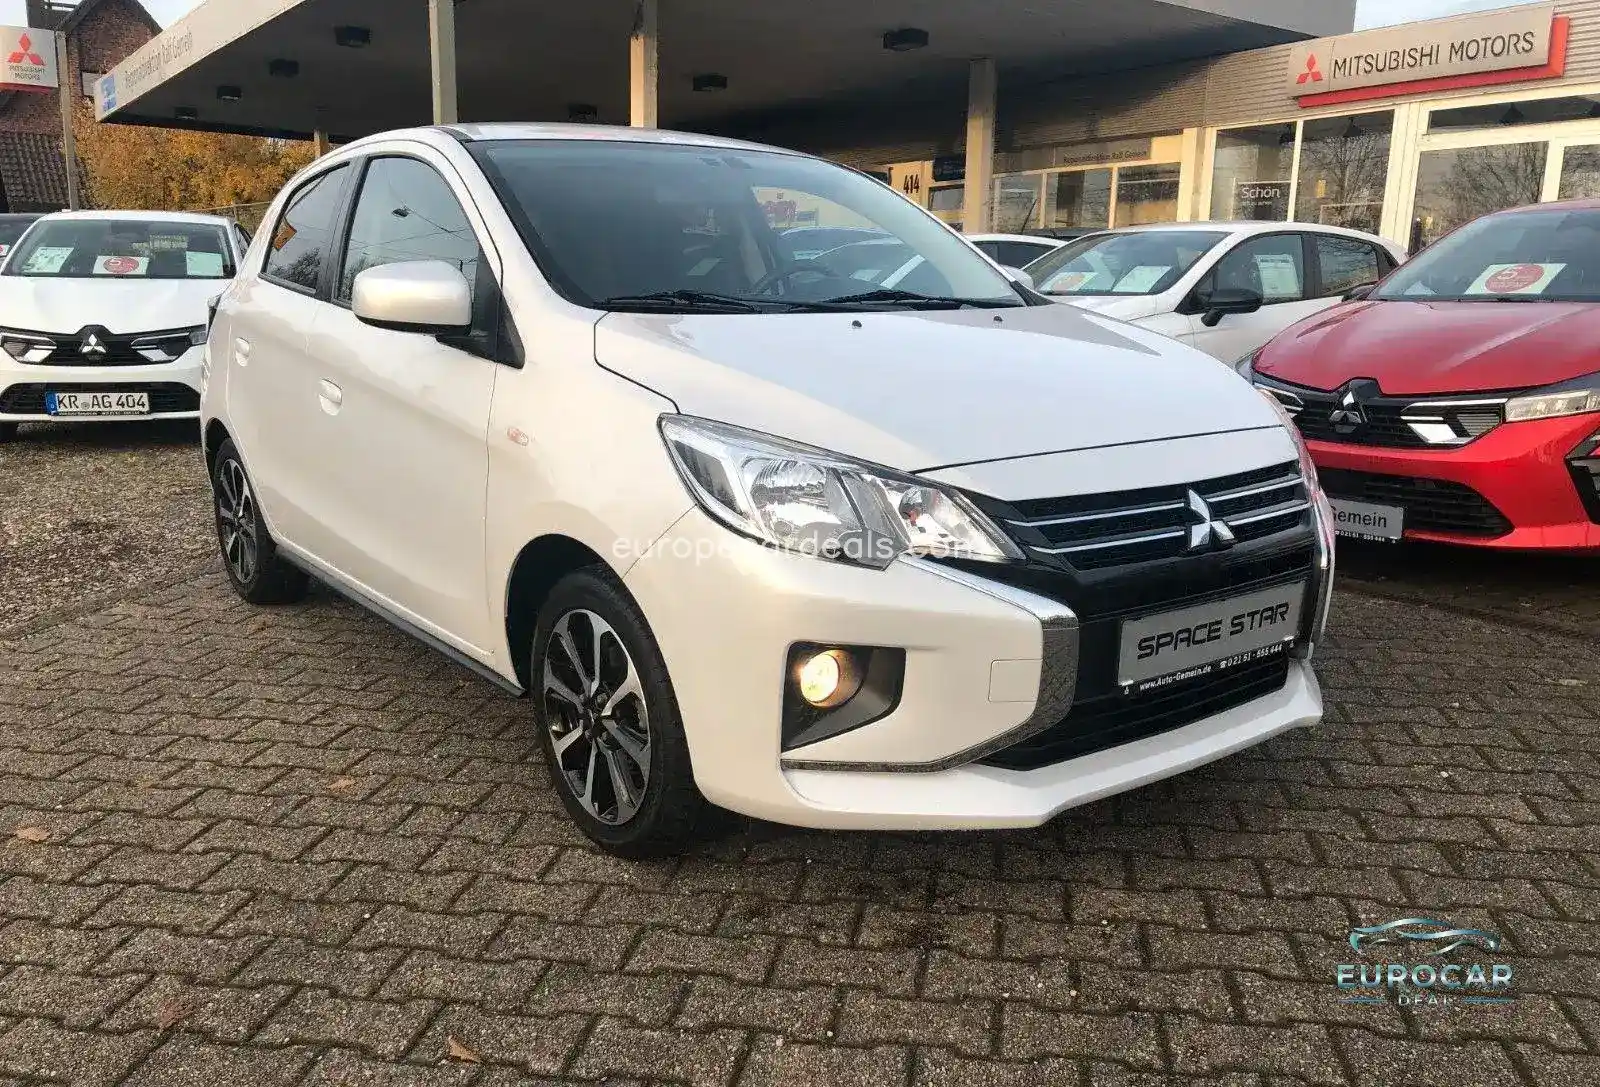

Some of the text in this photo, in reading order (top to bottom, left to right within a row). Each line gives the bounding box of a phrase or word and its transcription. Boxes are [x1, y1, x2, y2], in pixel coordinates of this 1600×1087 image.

[1333, 31, 1535, 78] MITSUBISHI MOTORS
[903, 174, 919, 194] 414
[1241, 186, 1280, 199] Schön
[57, 394, 146, 409] KR AG 404
[1137, 602, 1290, 660] SPACE STAR
[1139, 664, 1212, 691] www.Auto-Gemein.de
